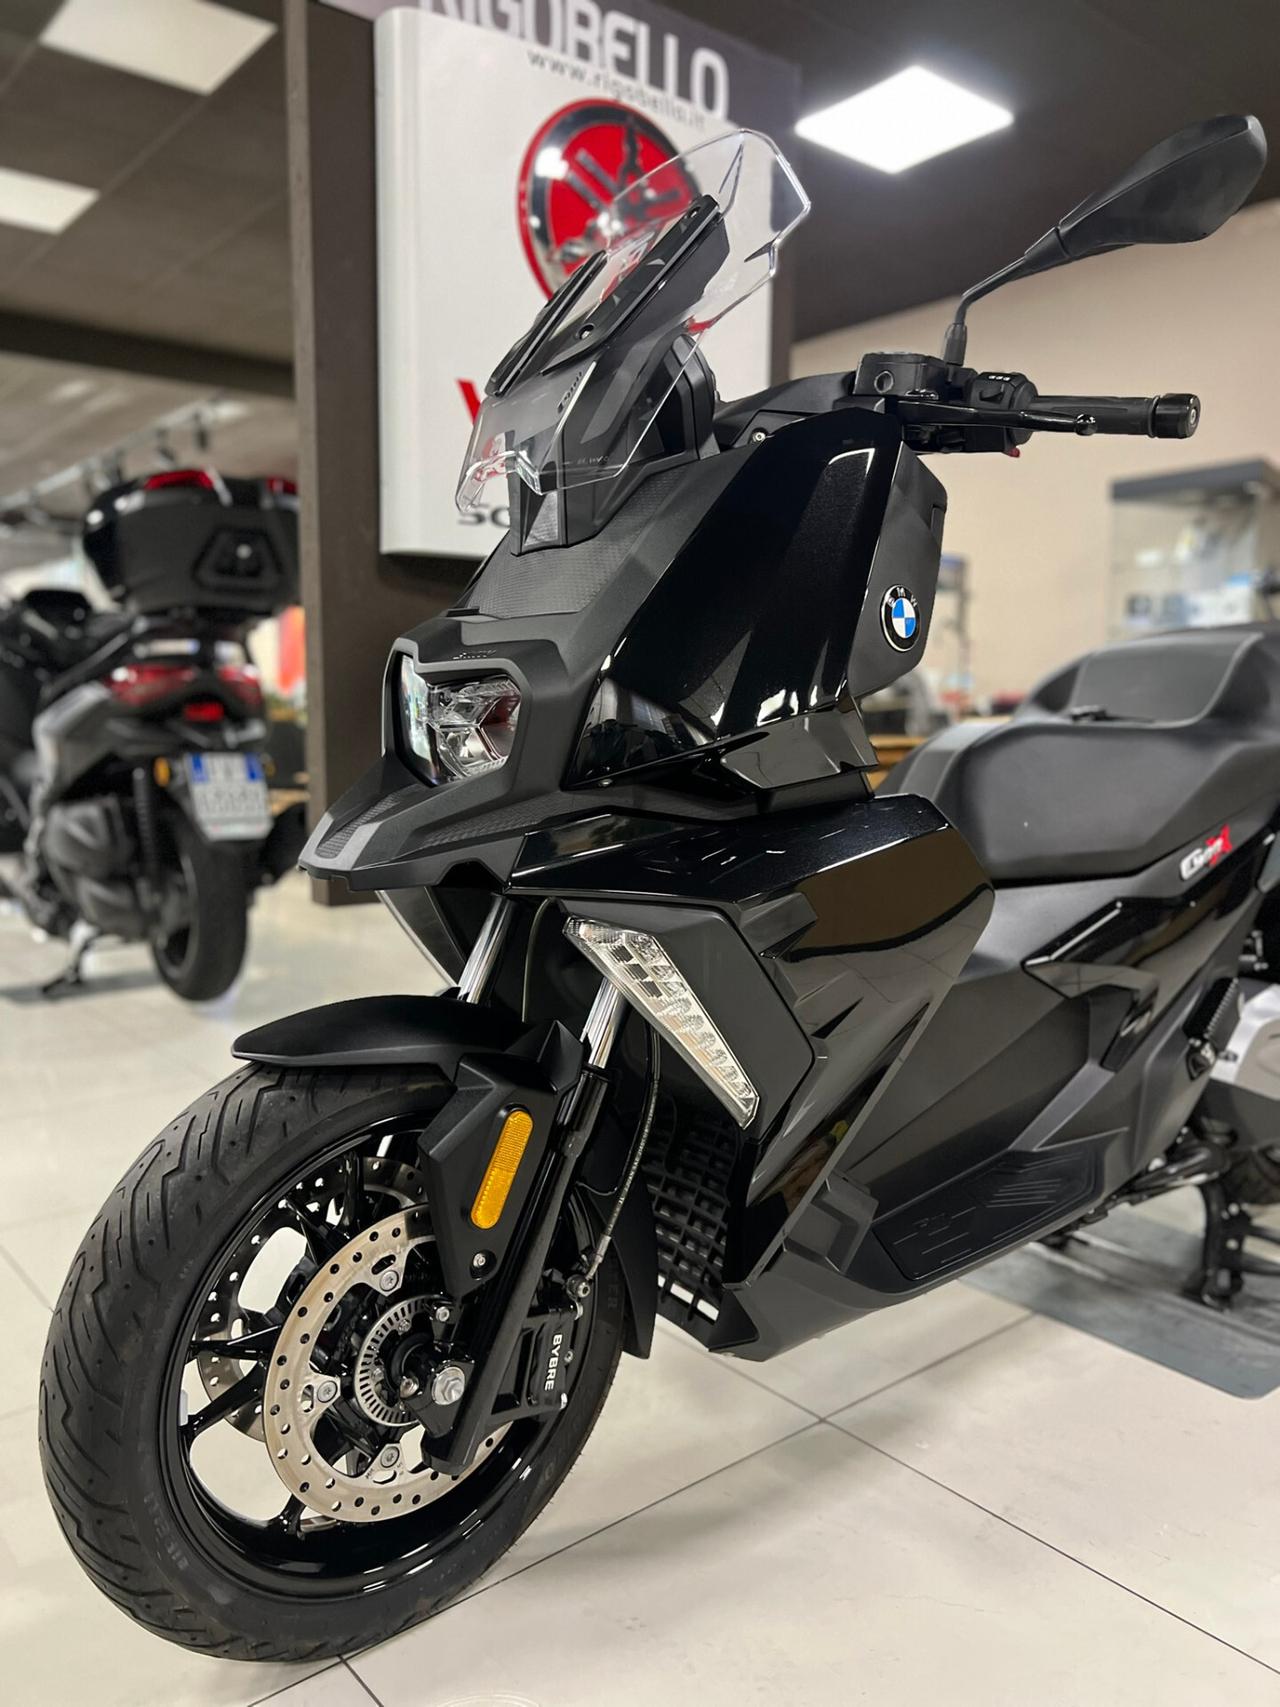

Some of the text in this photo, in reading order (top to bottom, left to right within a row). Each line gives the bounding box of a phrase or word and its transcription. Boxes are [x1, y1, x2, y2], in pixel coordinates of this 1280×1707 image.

[418, 0, 733, 121] GOBELLO
[887, 586, 919, 608] BMW
[544, 1334, 563, 1391] BYBRE
